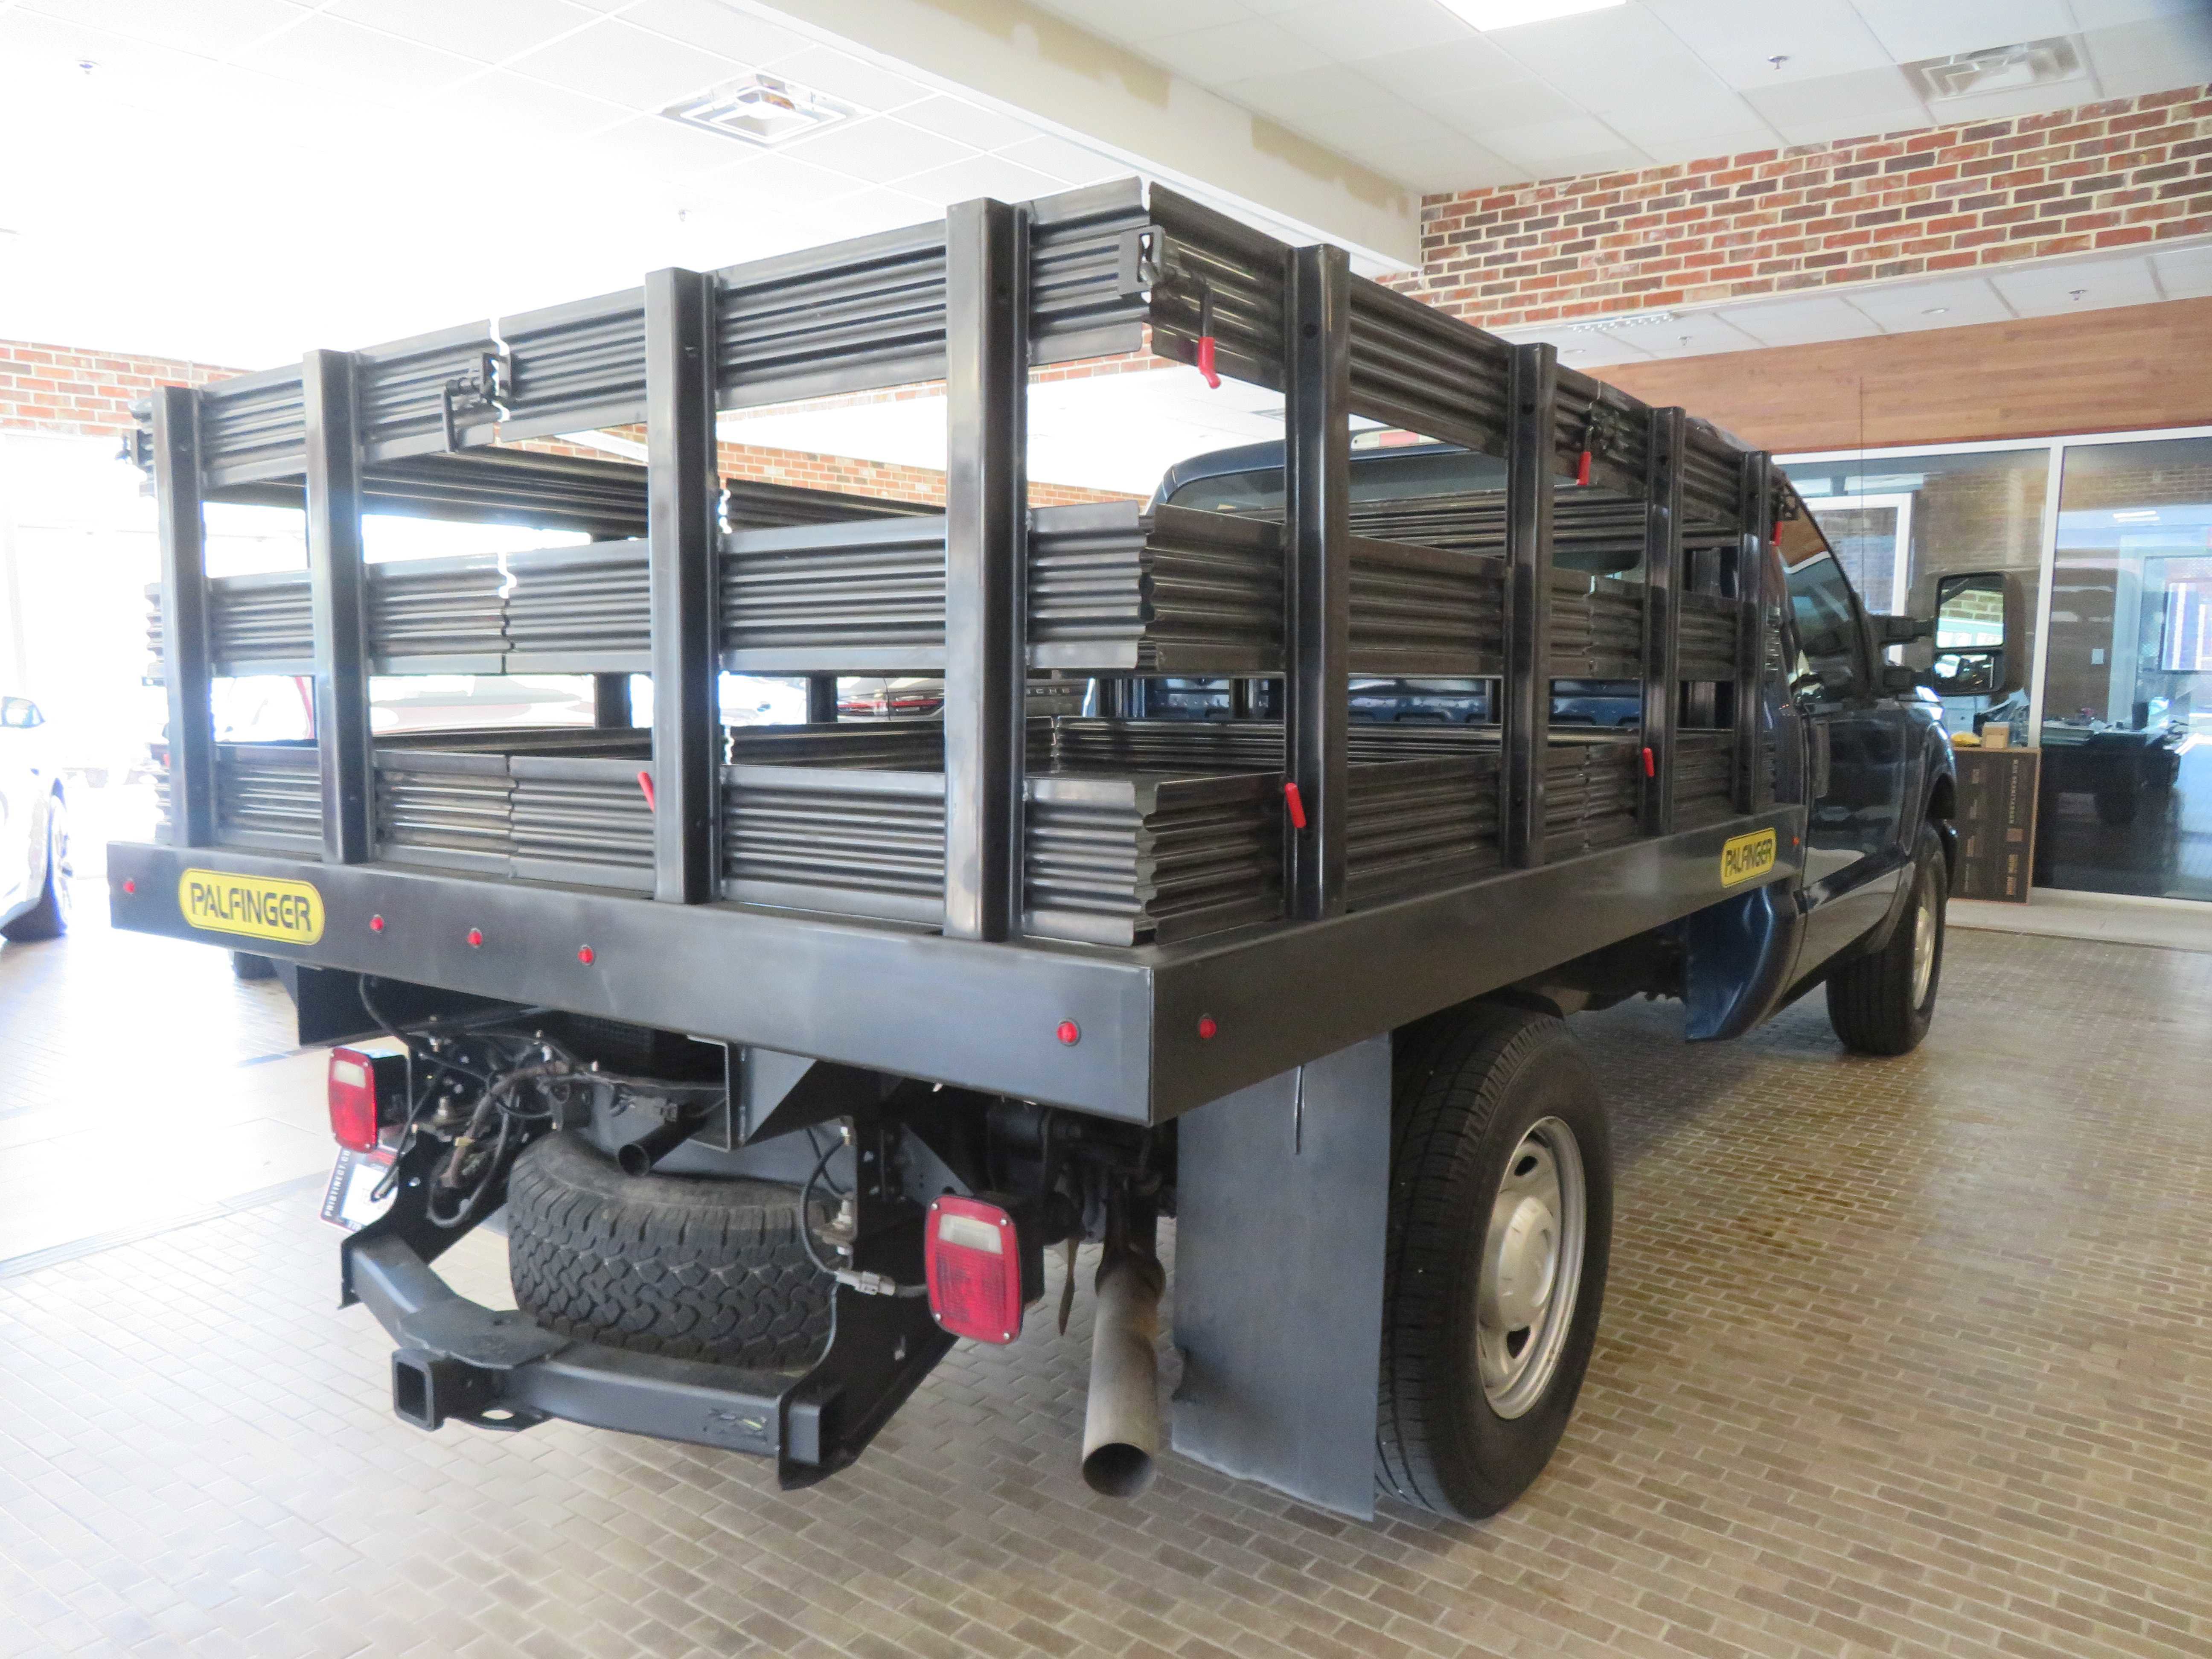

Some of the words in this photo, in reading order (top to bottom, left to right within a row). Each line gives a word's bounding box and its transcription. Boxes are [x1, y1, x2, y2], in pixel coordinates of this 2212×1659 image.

[1725, 838, 1772, 877] PALFINGER
[190, 882, 312, 932] PALFINGER
[325, 1150, 351, 1217] PRISTINECT.CO
